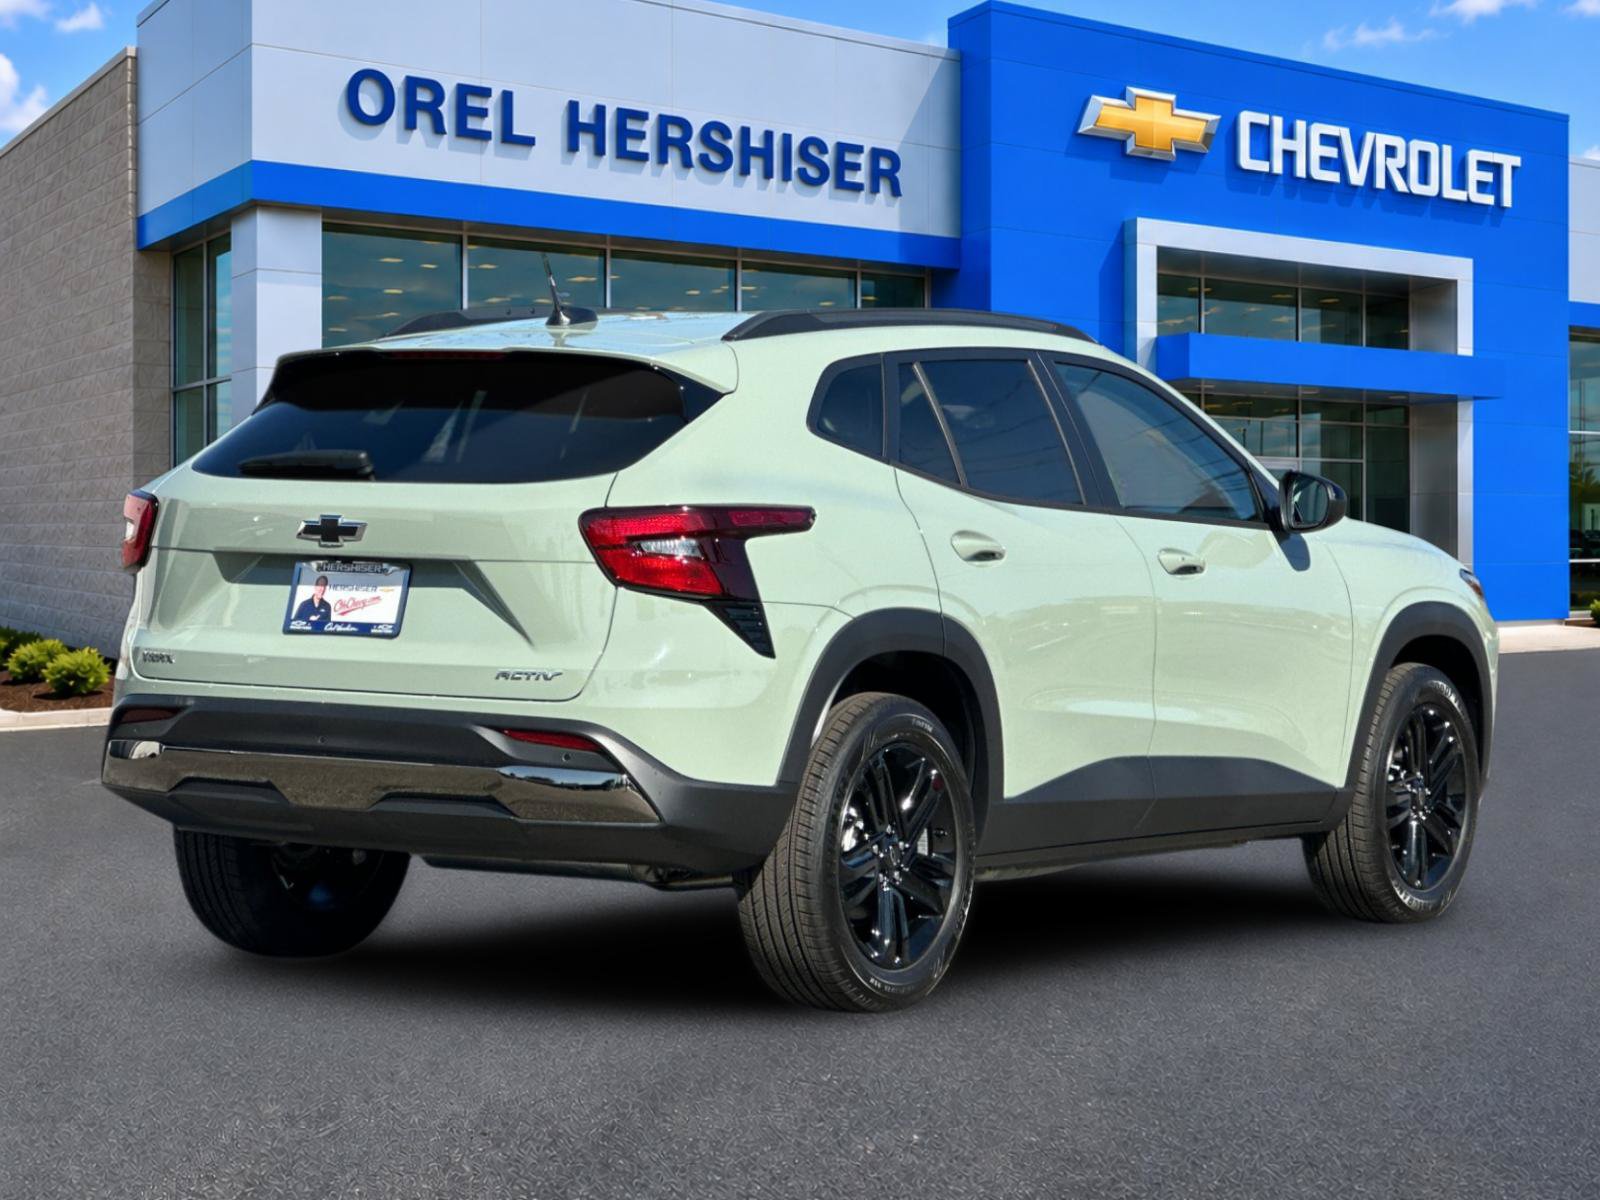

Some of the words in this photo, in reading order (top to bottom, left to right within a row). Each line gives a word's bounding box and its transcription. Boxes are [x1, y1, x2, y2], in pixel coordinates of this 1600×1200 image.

[346, 68, 535, 147] OREL
[567, 99, 903, 197] HERSHISER
[1237, 110, 1521, 207] CHEVROLET
[322, 563, 382, 573] HERSHISER
[495, 670, 564, 681] ACTIV
